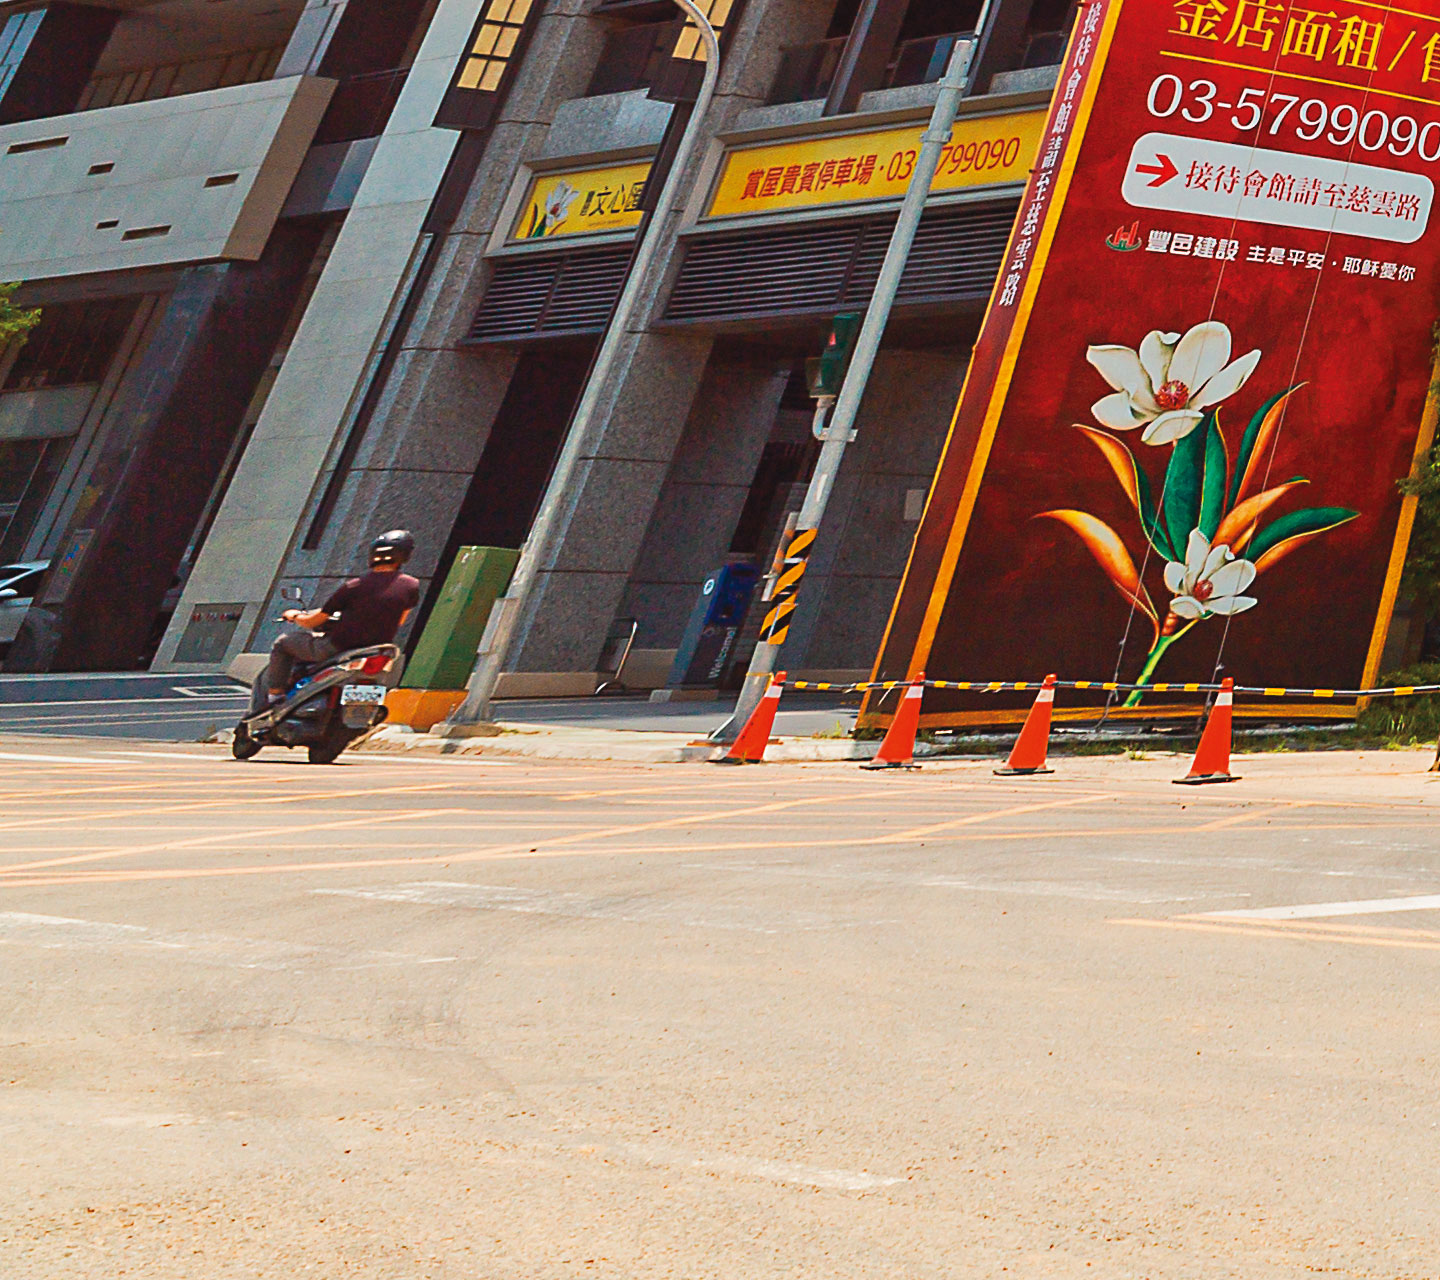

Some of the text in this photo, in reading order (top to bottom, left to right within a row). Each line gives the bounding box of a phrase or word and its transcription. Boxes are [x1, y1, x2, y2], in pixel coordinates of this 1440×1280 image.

[1185, 159, 1422, 223] 接待會館請至慈雲路
[1145, 229, 1240, 262] 豐邑建設
